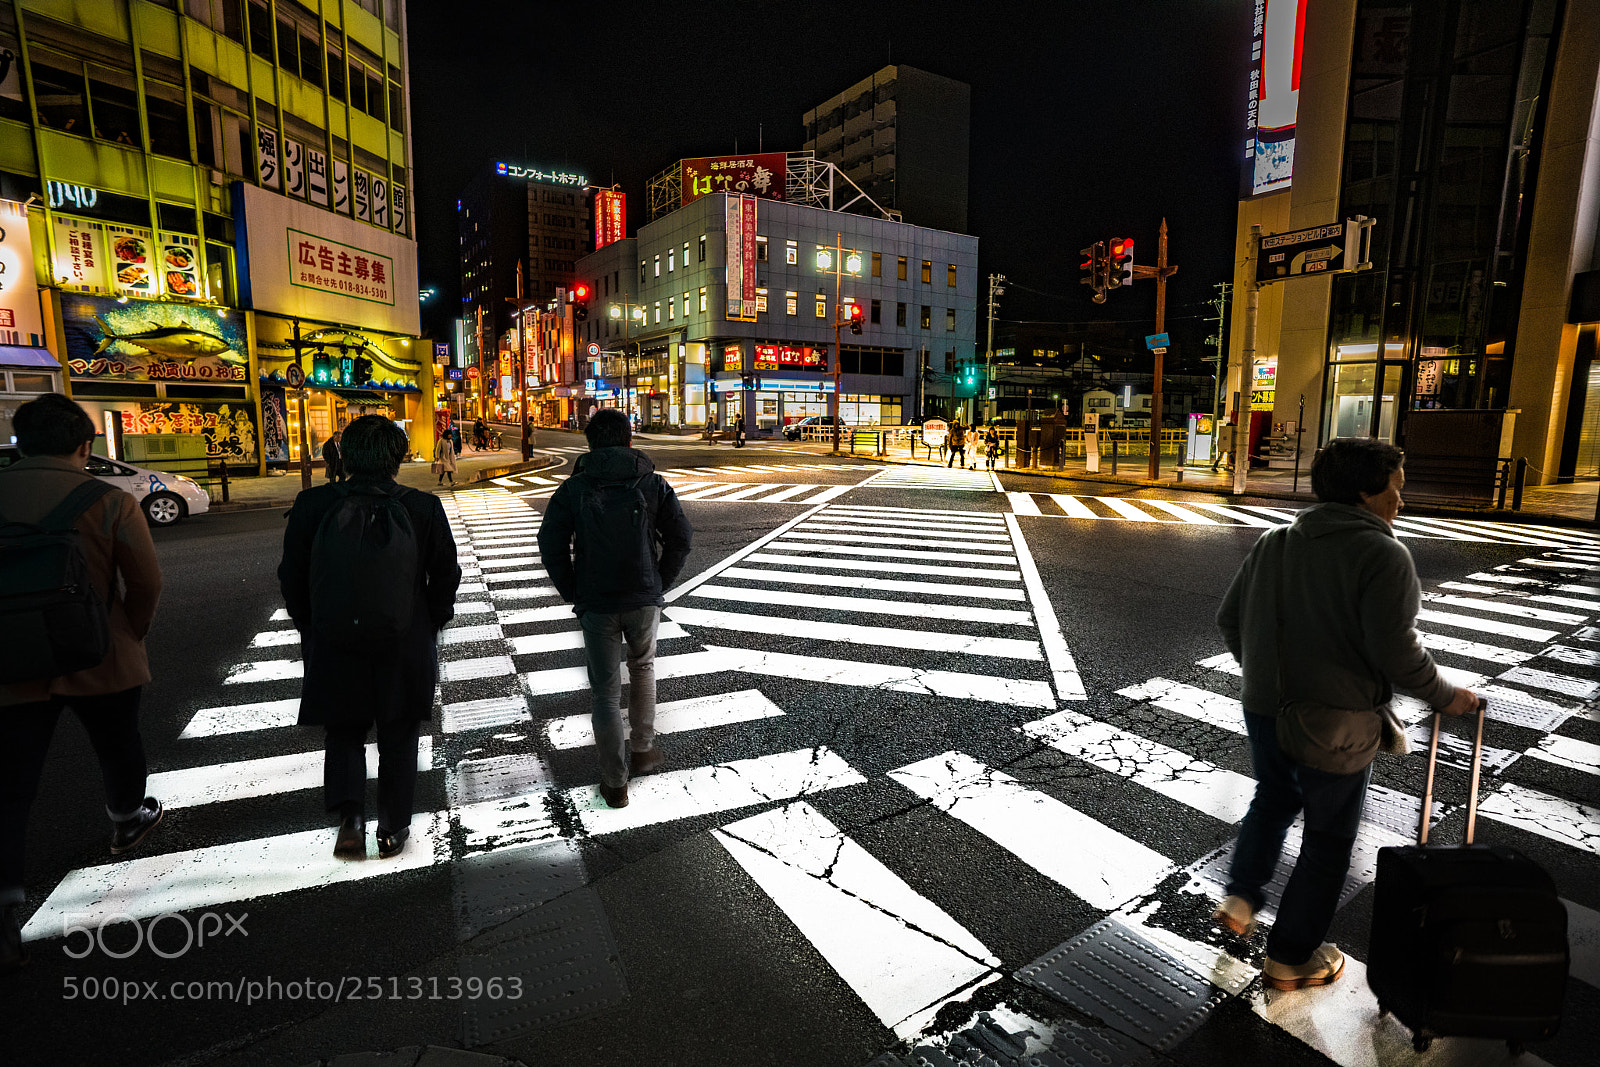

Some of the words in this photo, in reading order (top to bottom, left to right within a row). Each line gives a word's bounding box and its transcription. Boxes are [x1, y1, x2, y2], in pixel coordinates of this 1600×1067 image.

[508, 164, 588, 187] コンフォートホテル
[710, 159, 755, 171] 海鮮居酒屋
[260, 159, 404, 230] グリーンライフ
[692, 165, 774, 196] はなの舞
[298, 240, 386, 285] 広告主募集
[300, 271, 338, 289] お問合せ先
[339, 279, 388, 300] 018-834-5301
[68, 358, 247, 381] マグロ一本買いのお店
